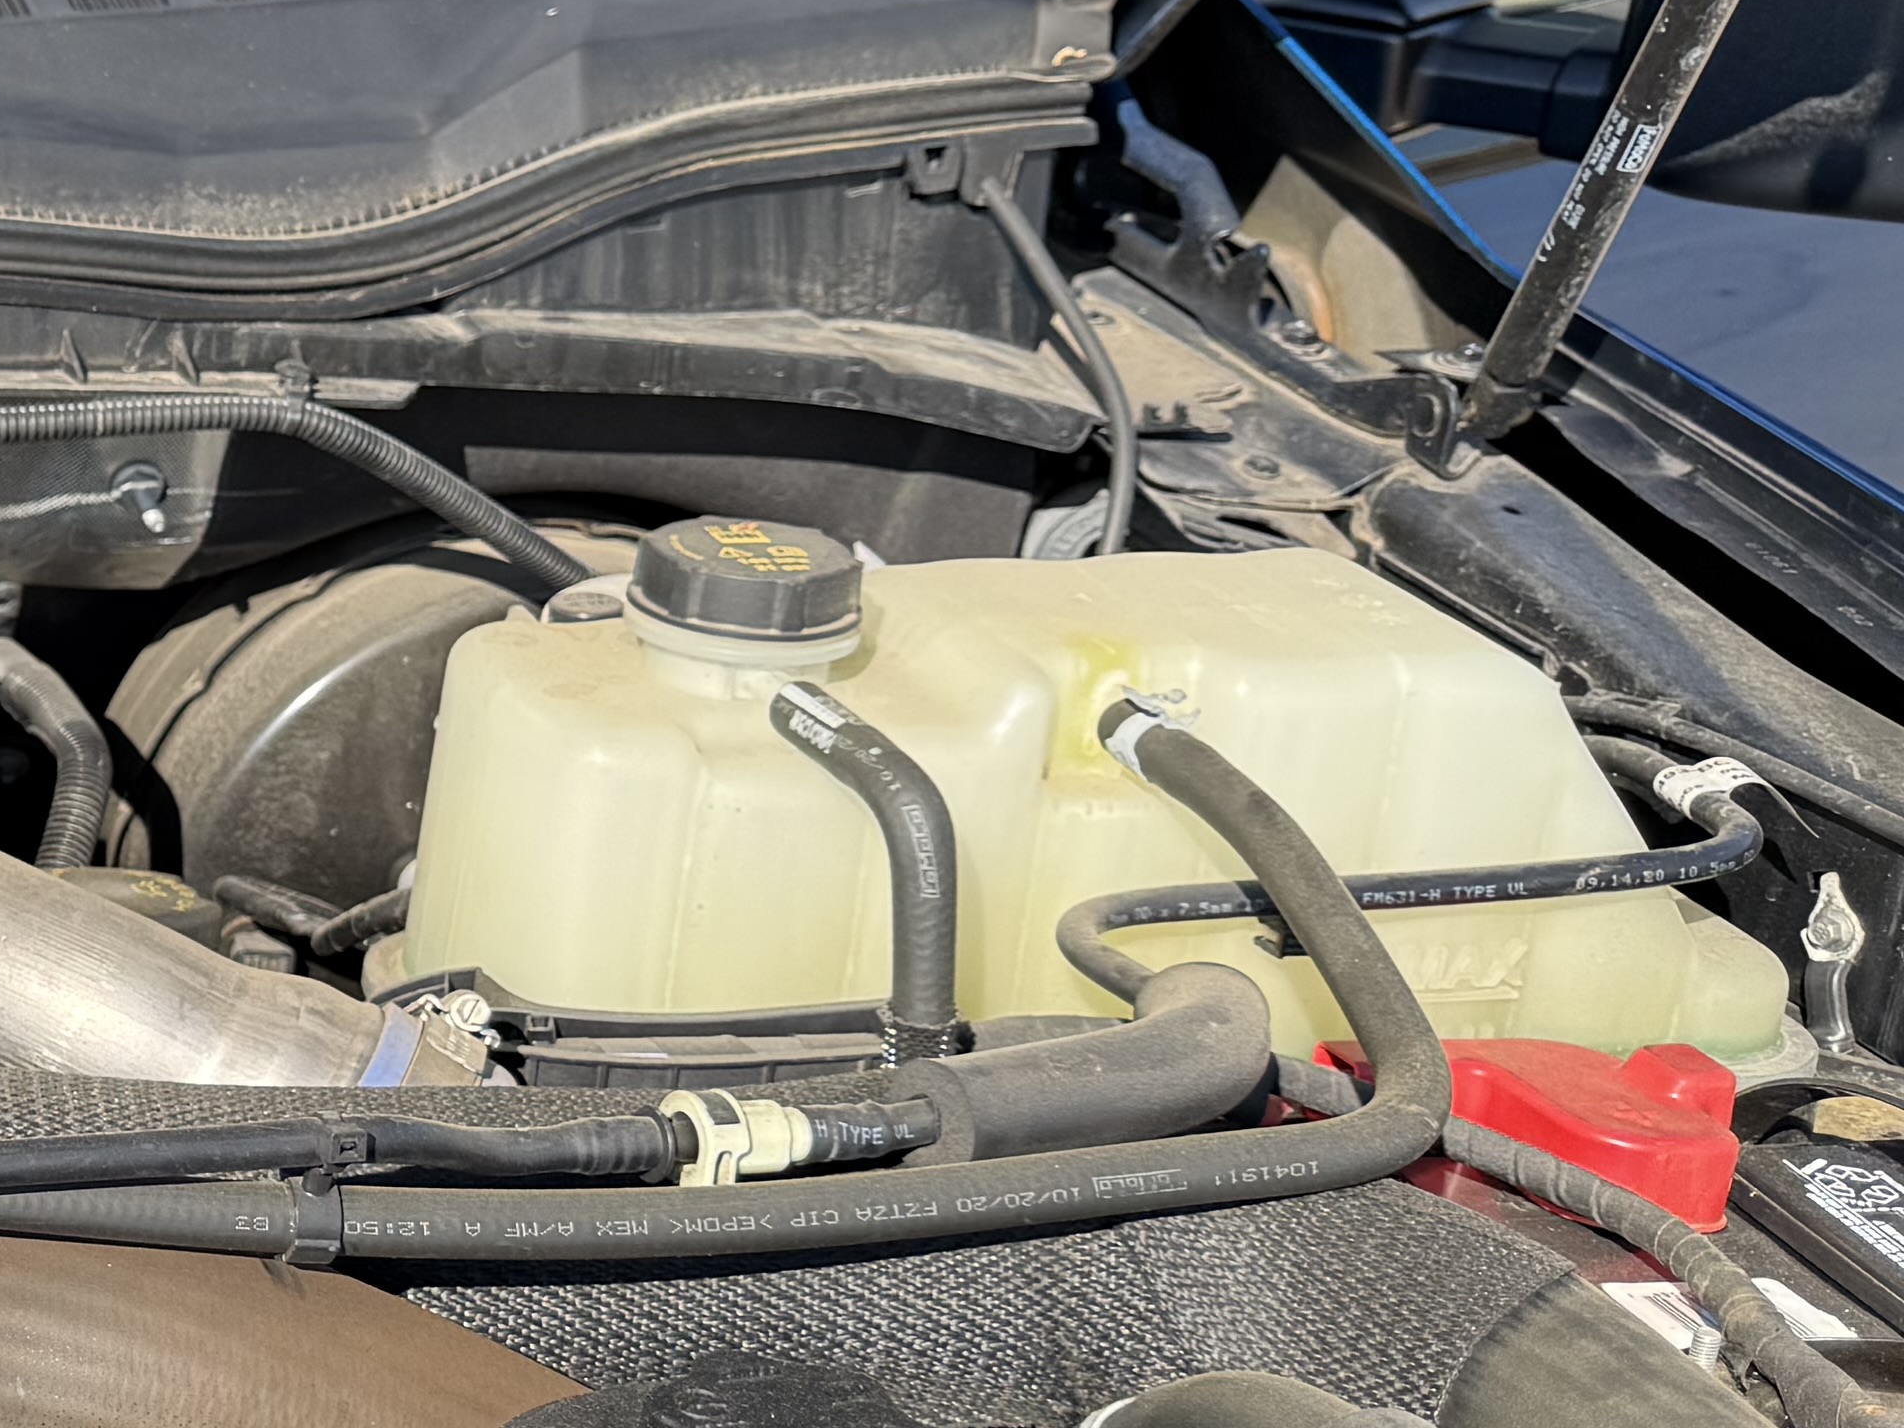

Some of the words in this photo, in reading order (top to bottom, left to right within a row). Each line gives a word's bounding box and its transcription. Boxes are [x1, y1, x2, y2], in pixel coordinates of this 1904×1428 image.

[1452, 885, 1496, 900] TYPE
[839, 1121, 885, 1146] TYPE
[956, 1186, 1081, 1213] 10/20/20
[790, 1209, 840, 1228] CIP
[464, 1220, 481, 1238] A
[504, 1219, 575, 1237] A/MF
[596, 1220, 649, 1237] MEX
